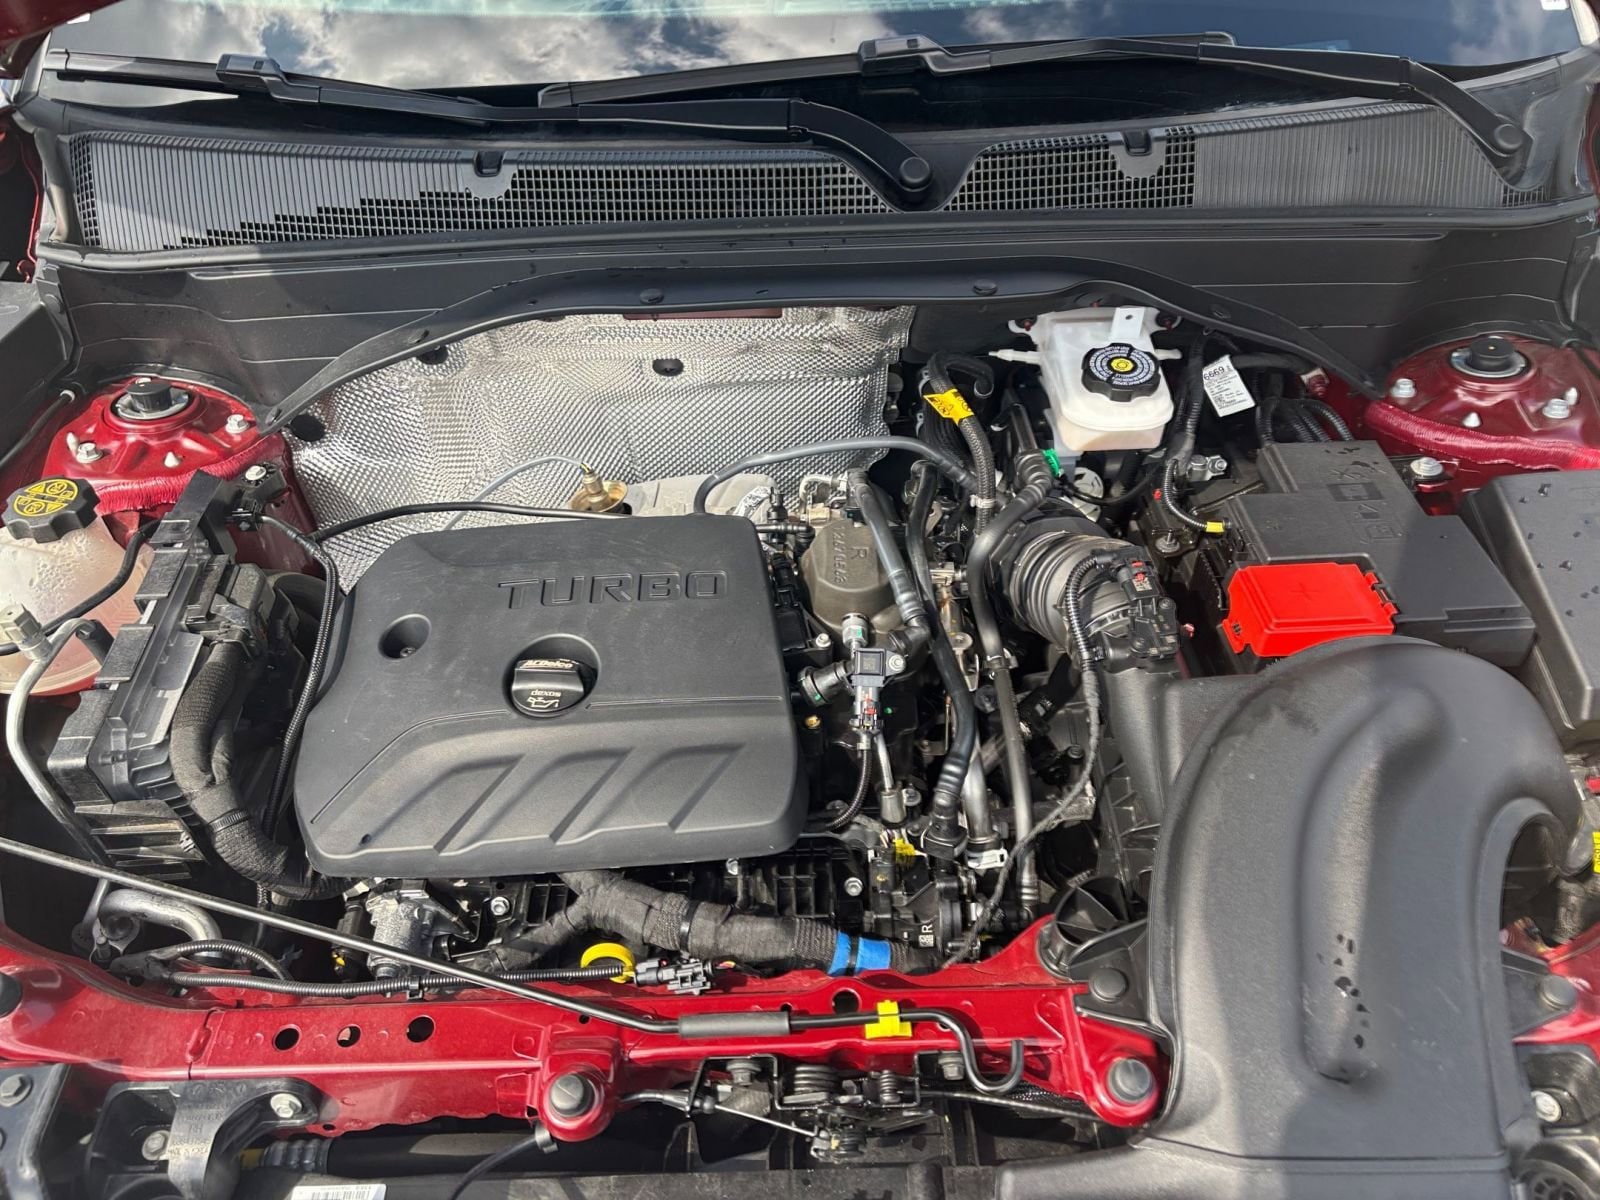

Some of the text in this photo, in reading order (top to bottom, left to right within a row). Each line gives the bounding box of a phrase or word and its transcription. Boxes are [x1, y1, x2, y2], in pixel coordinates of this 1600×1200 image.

[498, 570, 728, 610] TURBO
[519, 659, 573, 670] ACDelco
[530, 688, 562, 698] dexos
[921, 923, 933, 933] R
